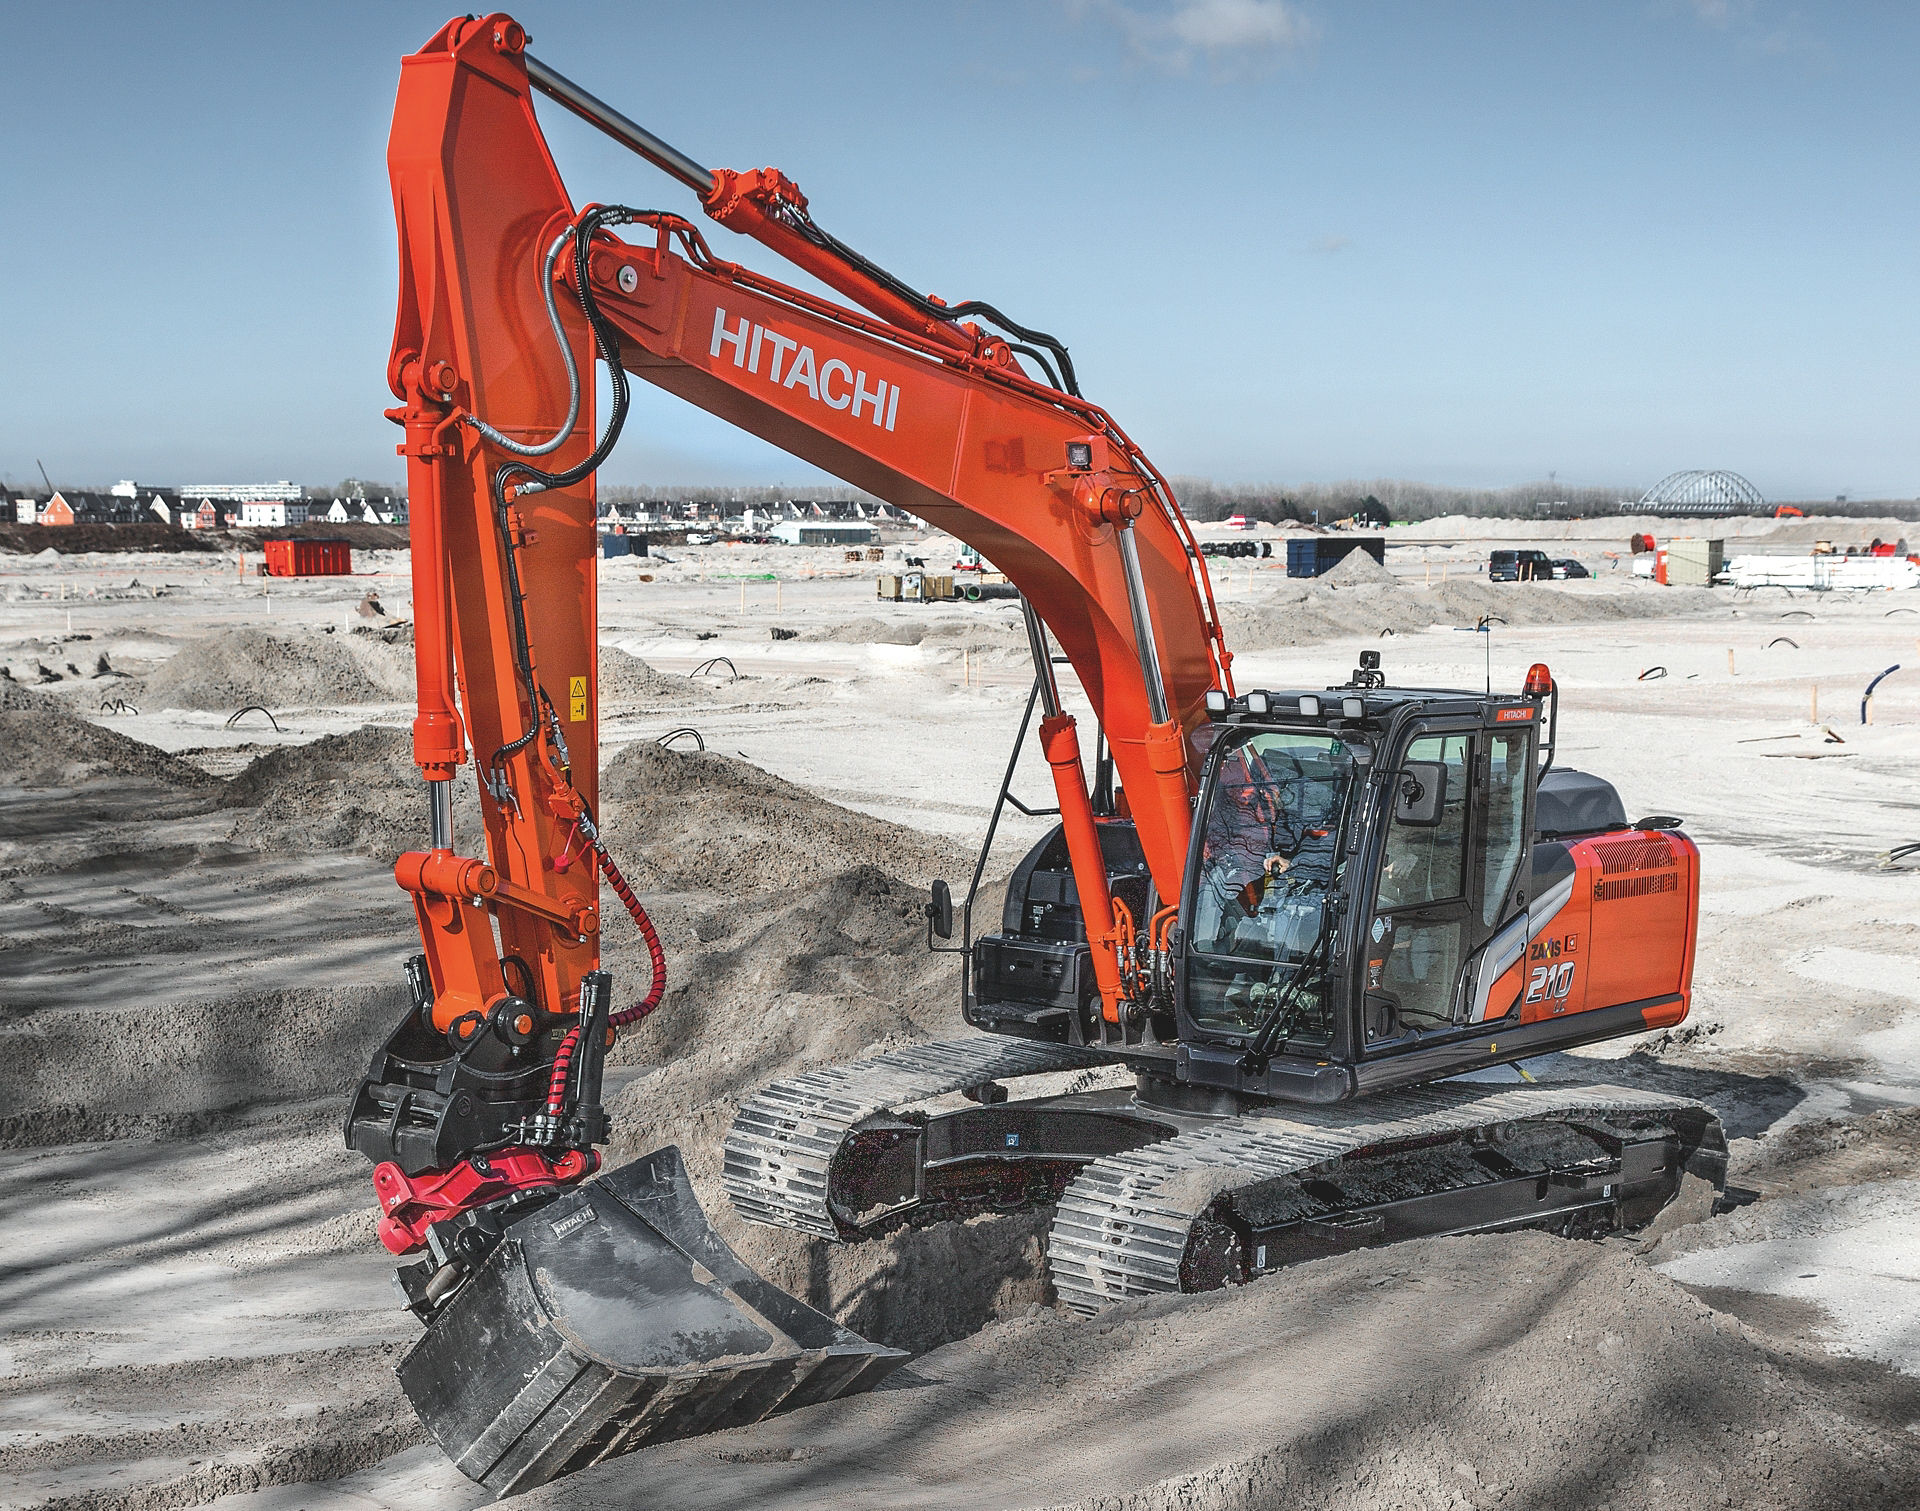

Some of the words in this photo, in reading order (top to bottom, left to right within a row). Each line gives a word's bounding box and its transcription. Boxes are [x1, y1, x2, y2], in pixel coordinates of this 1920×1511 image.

[709, 306, 901, 432] HITACHI
[1503, 709, 1527, 719] HITACHI
[1531, 938, 1561, 960] ZAXIS
[1526, 961, 1575, 1003] 210
[556, 1208, 594, 1233] HITACHI
